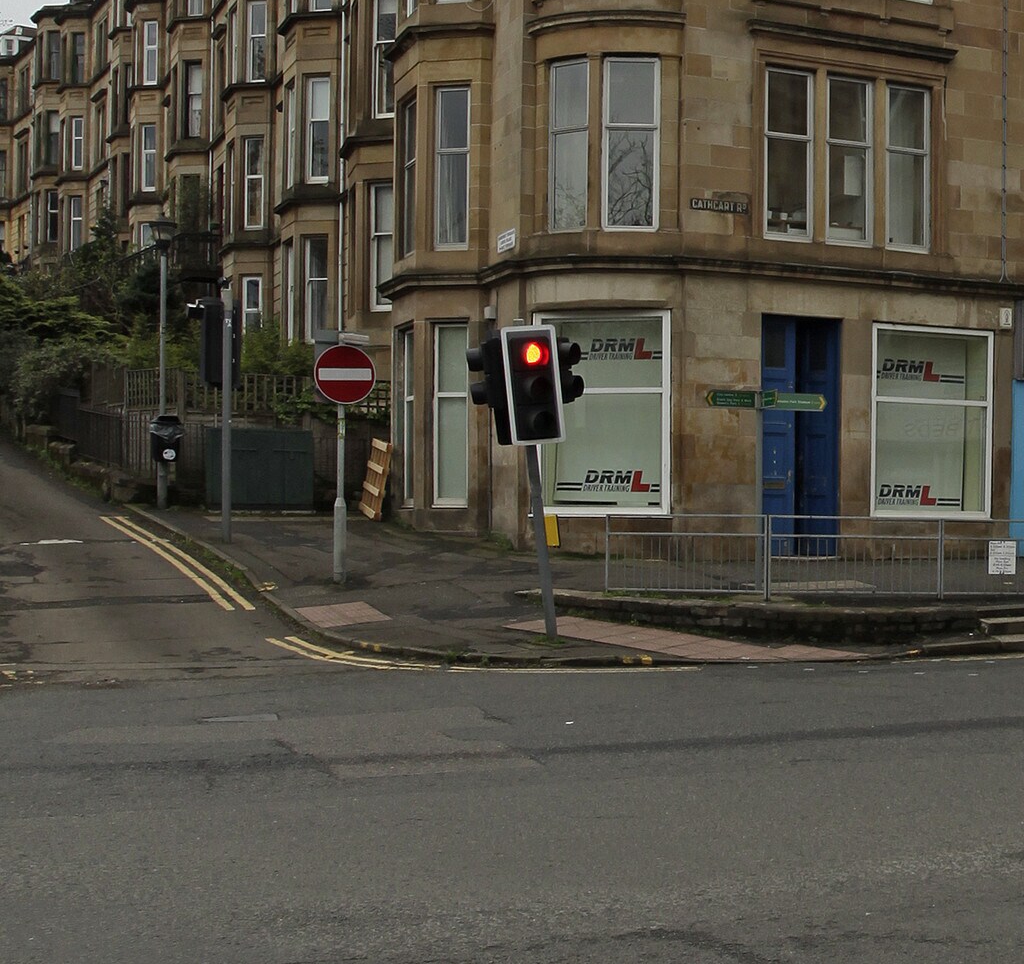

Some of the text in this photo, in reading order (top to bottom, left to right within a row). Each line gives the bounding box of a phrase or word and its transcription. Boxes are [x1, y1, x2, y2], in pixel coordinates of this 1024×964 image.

[692, 198, 734, 211] CATHCART
[583, 484, 630, 493] DRIVER TRAINING
[877, 497, 896, 506] DRIVER
